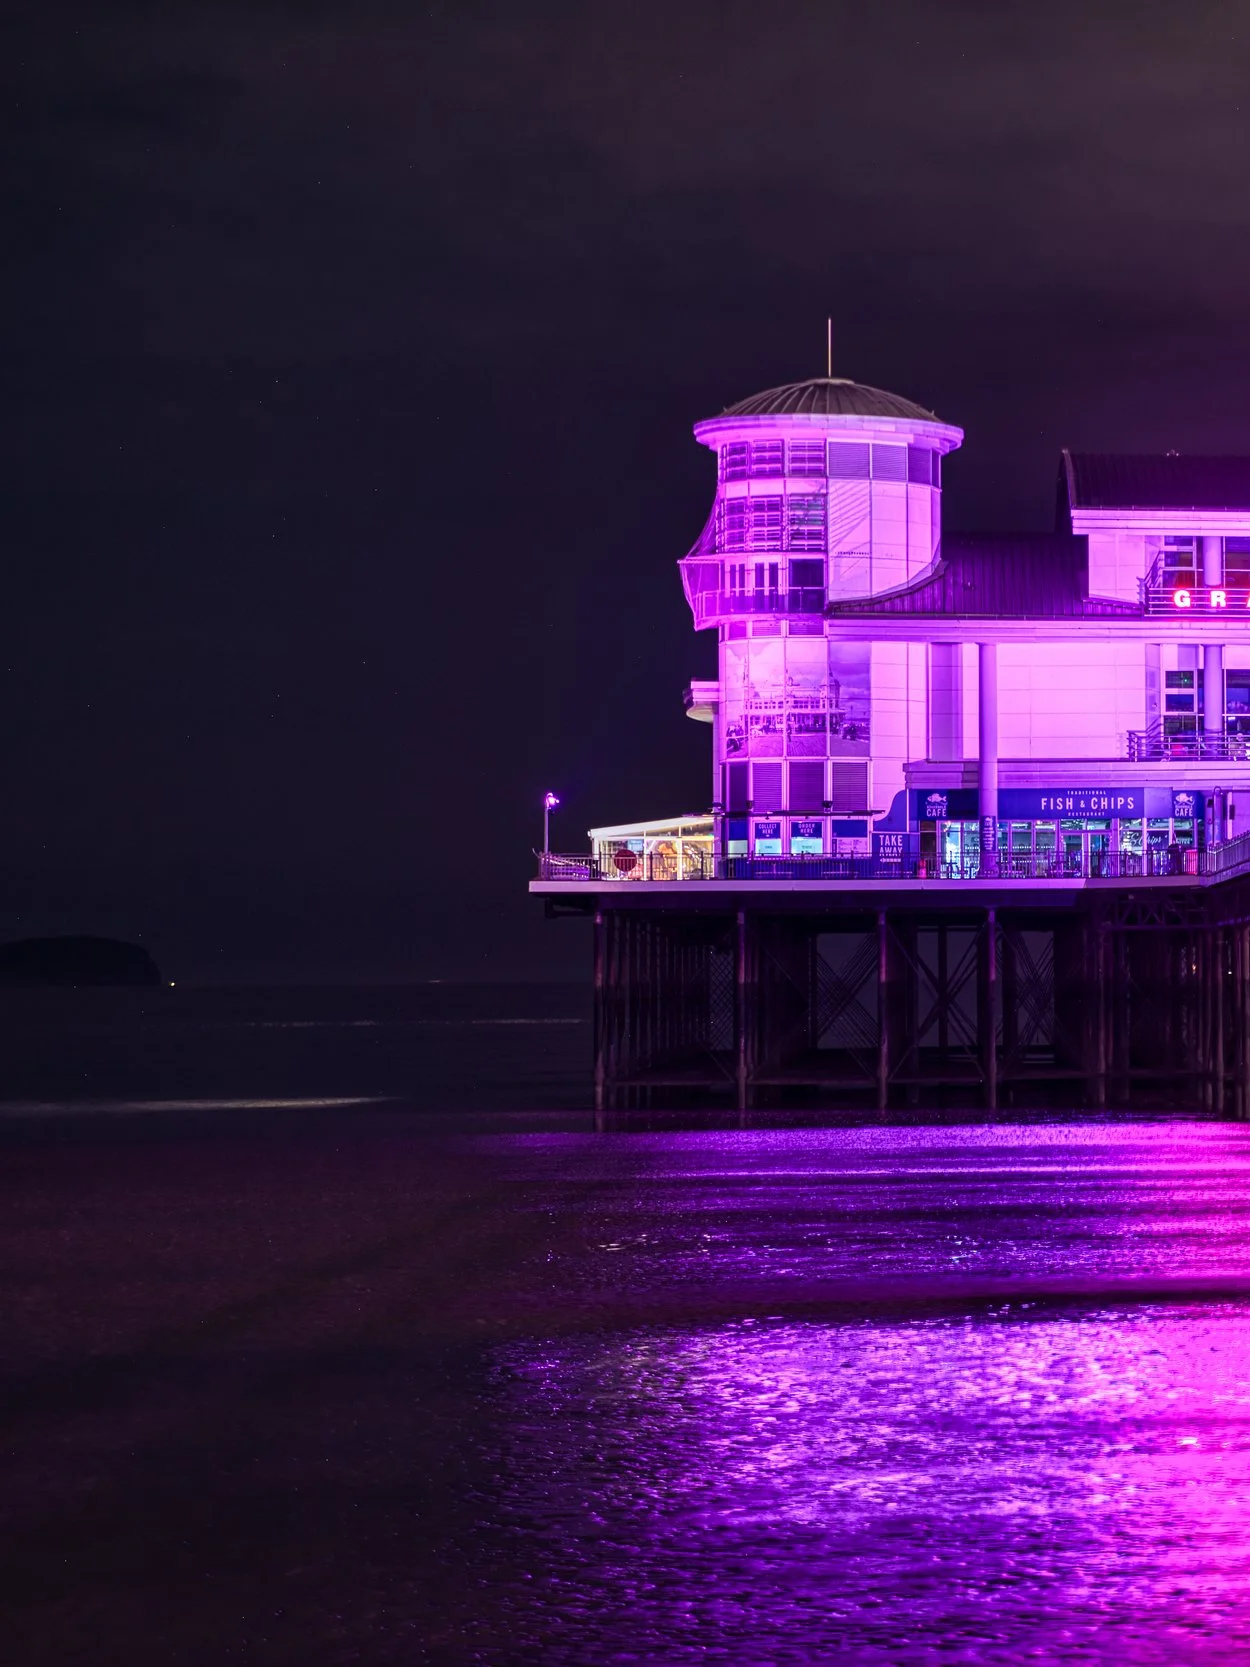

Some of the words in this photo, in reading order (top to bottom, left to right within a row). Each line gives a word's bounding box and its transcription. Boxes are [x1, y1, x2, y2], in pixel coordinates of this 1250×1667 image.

[1041, 797, 1073, 810] FISH
[1079, 799, 1086, 809] &
[1090, 796, 1135, 810] CHIPS
[879, 834, 903, 846] TAKE
[879, 846, 903, 857] AWAY
